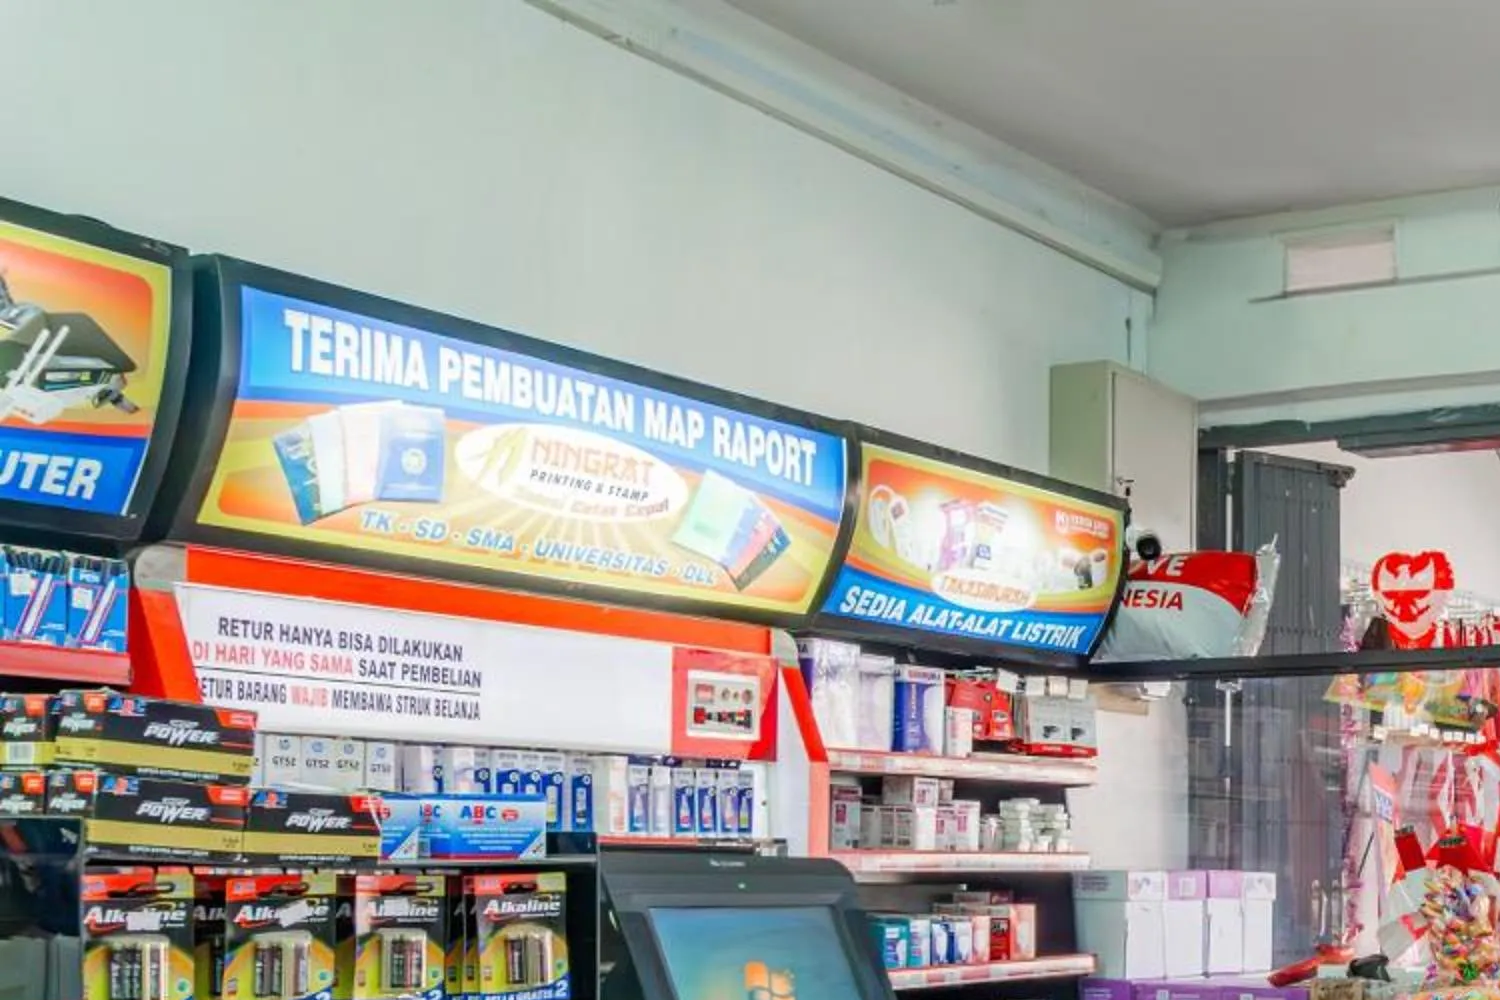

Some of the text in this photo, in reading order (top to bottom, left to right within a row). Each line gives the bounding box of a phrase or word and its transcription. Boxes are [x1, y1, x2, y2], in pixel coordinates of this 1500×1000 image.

[284, 308, 816, 486] TERIMA PEMBUATAN MAP RAPORT
[531, 437, 656, 483] NINGRAT
[529, 468, 593, 493] PRINTING
[607, 485, 650, 502] STAMP
[362, 509, 392, 532] TK
[414, 520, 447, 541] SD
[466, 527, 515, 552] SMA
[534, 538, 670, 577] UNIVERSITAS
[840, 585, 907, 621] SEDIA
[908, 602, 1013, 640] ALAT-ALAT
[1011, 622, 1088, 650] LISTRIK
[218, 616, 463, 662] RETUR HANYA BISA DILAKUKAN
[192, 640, 482, 689] DI HARI YANG SAMA SAAT PEMBELIAN
[197, 676, 234, 700] ETUR
[237, 680, 287, 705] BARANG
[332, 688, 393, 713] MEMBAWA
[395, 695, 433, 717] STRUK
[434, 698, 480, 721] BELANJA
[143, 722, 219, 746] POWER
[136, 802, 211, 823] POWER
[285, 813, 350, 833] POWER
[460, 803, 496, 820] ABC
[484, 899, 561, 917] Alkaline
[554, 980, 569, 998] 2
